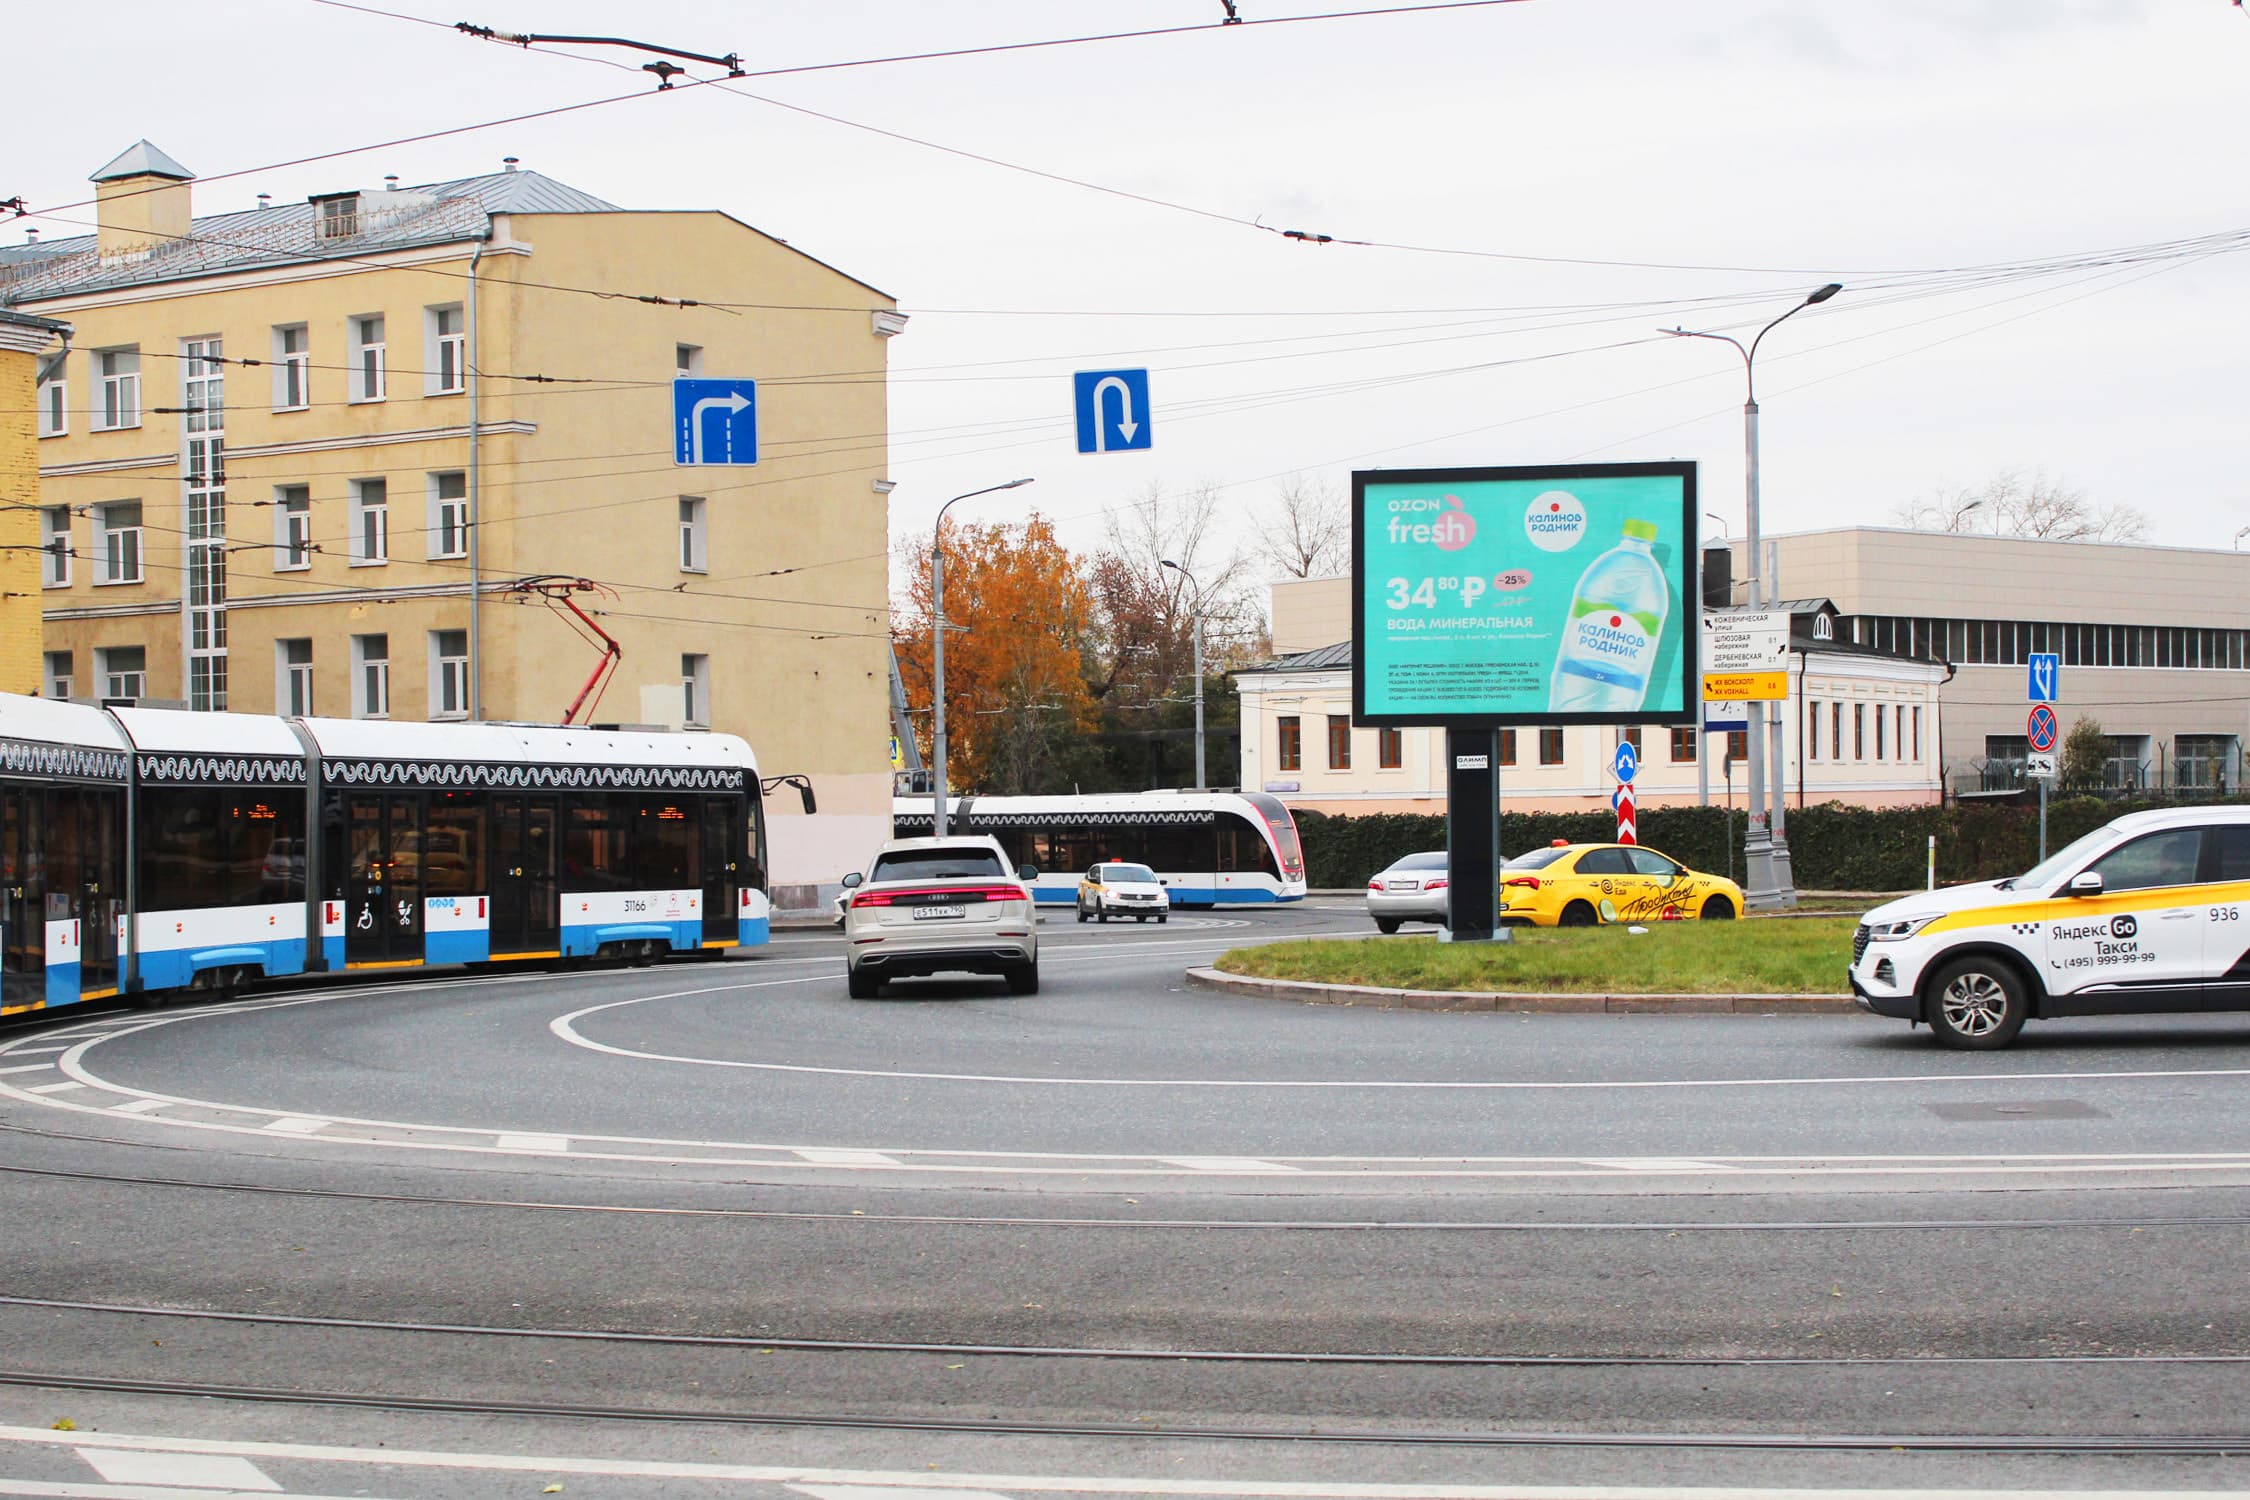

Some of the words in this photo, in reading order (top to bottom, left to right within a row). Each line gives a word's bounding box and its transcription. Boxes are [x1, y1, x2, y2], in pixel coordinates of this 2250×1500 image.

[1387, 515, 1466, 543] fresh
[1531, 523, 1579, 533] РОДНИК
[1387, 619, 1426, 631] ВОДА
[1429, 617, 1533, 629] МИНЕРАЛЬНАЯ
[1714, 614, 1768, 623] КОЖЕВНИЧЕСКАЯ
[1714, 634, 1751, 642] ШЛЮЗОВАЯ
[624, 900, 646, 912] 31166
[2210, 907, 2239, 922] 936
[2053, 924, 2107, 940] Яндекс
[2112, 920, 2135, 935] Go
[2094, 941, 2137, 955] Такси
[2064, 957, 2093, 969] (495)
[2097, 952, 2155, 966] 999-99-99
